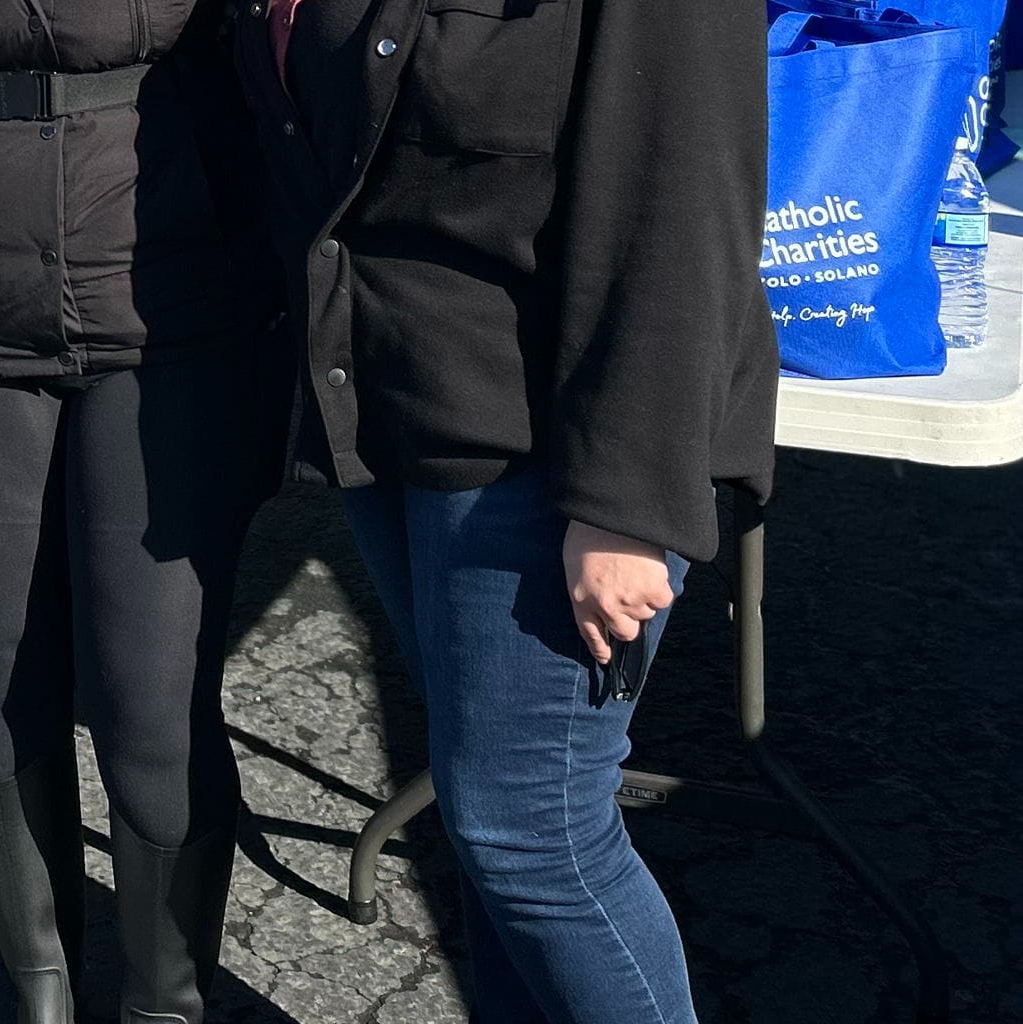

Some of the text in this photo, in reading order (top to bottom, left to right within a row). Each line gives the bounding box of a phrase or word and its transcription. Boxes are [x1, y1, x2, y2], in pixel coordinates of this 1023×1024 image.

[764, 195, 863, 233] atholic
[761, 263, 880, 287] OLO SOLANO
[622, 786, 658, 800] ETIME
